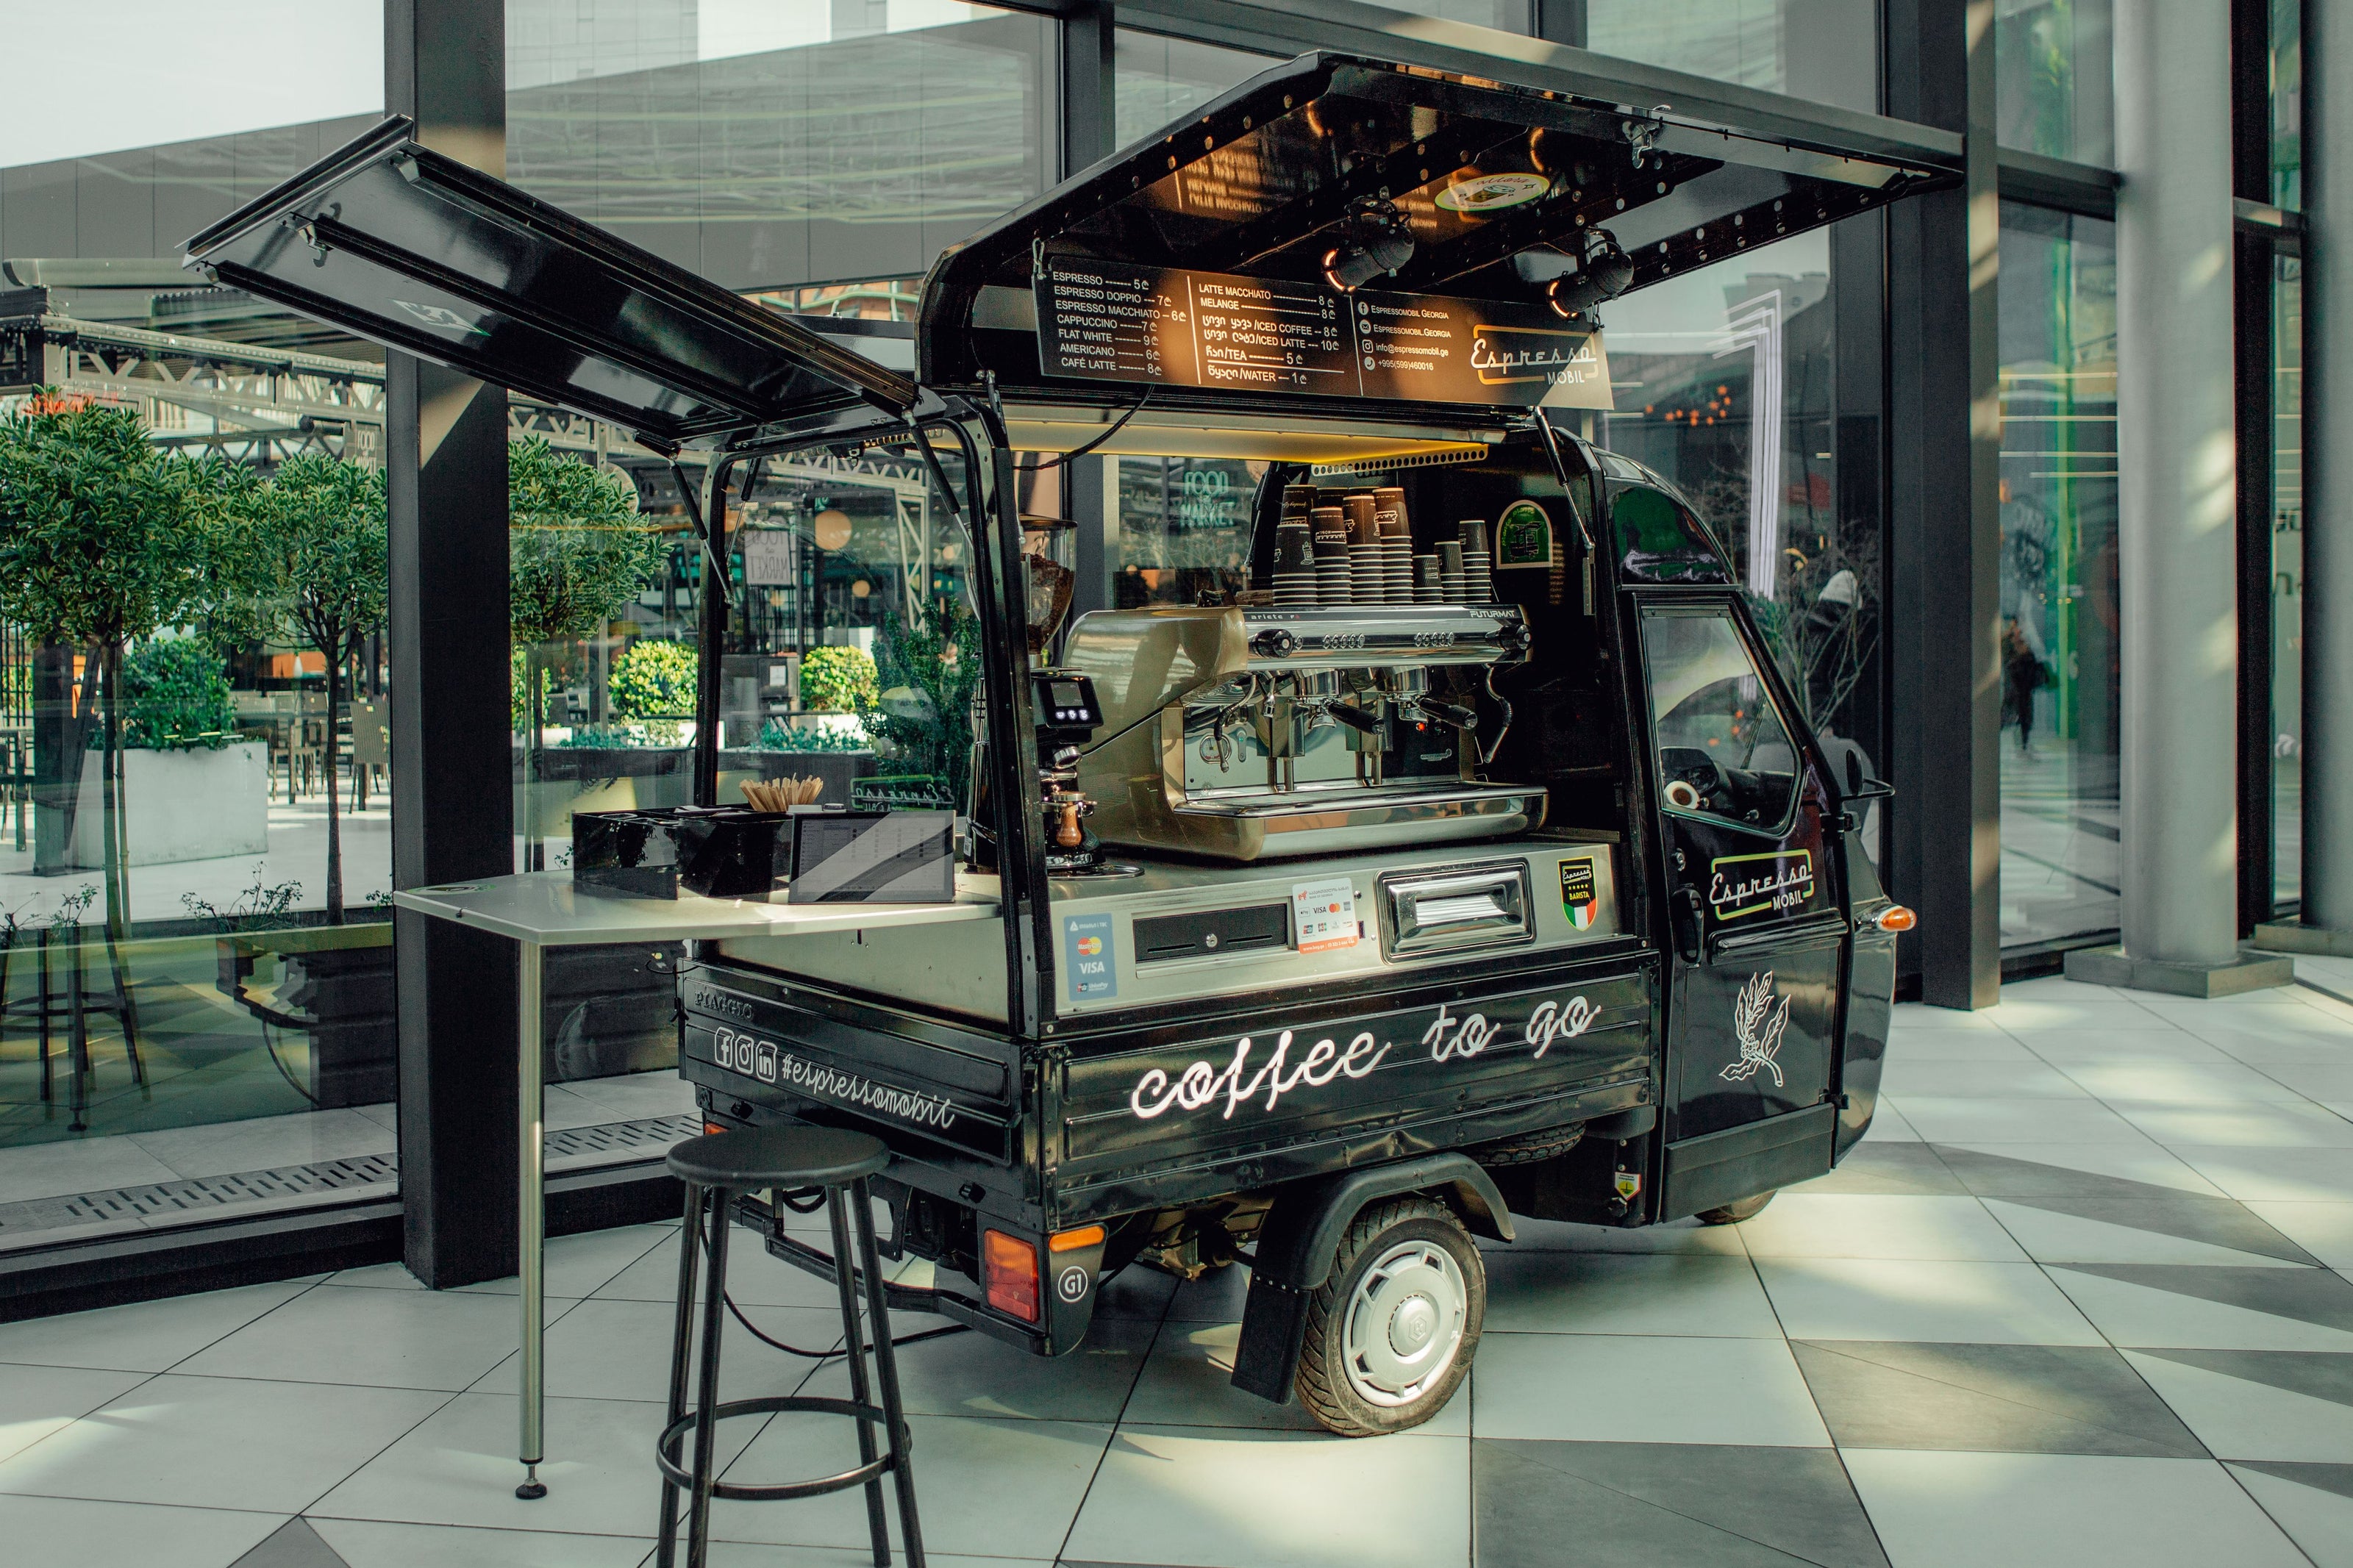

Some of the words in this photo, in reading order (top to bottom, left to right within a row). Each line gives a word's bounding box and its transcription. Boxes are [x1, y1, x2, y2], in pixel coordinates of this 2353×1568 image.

[1053, 271, 1102, 285] ESPRESSO
[1054, 285, 1104, 299] ESPRESSO
[1107, 291, 1140, 304] DOPPIO
[1199, 284, 1224, 295] LATTE
[1225, 287, 1271, 300] MACCHIATO
[1055, 300, 1105, 314] ESPRESSO
[1109, 306, 1160, 319] MACCHIATO
[1200, 297, 1240, 310] MELANGE
[1057, 315, 1118, 329] CAPPUCCINO
[1279, 323, 1313, 335] COFFEE
[1059, 329, 1080, 339] FLAT
[1082, 331, 1113, 343] WHITE
[1280, 337, 1306, 348] LATTE
[1060, 343, 1115, 357] AMERICANO
[1375, 343, 1449, 358] info@espressomobil.ge
[1471, 338, 1597, 374] Espresso
[1061, 357, 1086, 368] CAFÉ
[1088, 360, 1116, 370] LATTE
[1546, 370, 1585, 385] MOBIL
[1185, 471, 1229, 495] FOOD
[1709, 864, 1813, 906] Espresso
[1569, 891, 1590, 901] BARISTA
[1773, 889, 1804, 911] MOBIL
[1078, 961, 1105, 974] VISA
[694, 992, 754, 1020] PIAGGIO
[1131, 1030, 1392, 1119] coffee
[1422, 1004, 1500, 1062] to
[1526, 996, 1602, 1059] go
[782, 1053, 956, 1129] #espressomobil
[1064, 1273, 1082, 1294] G1
